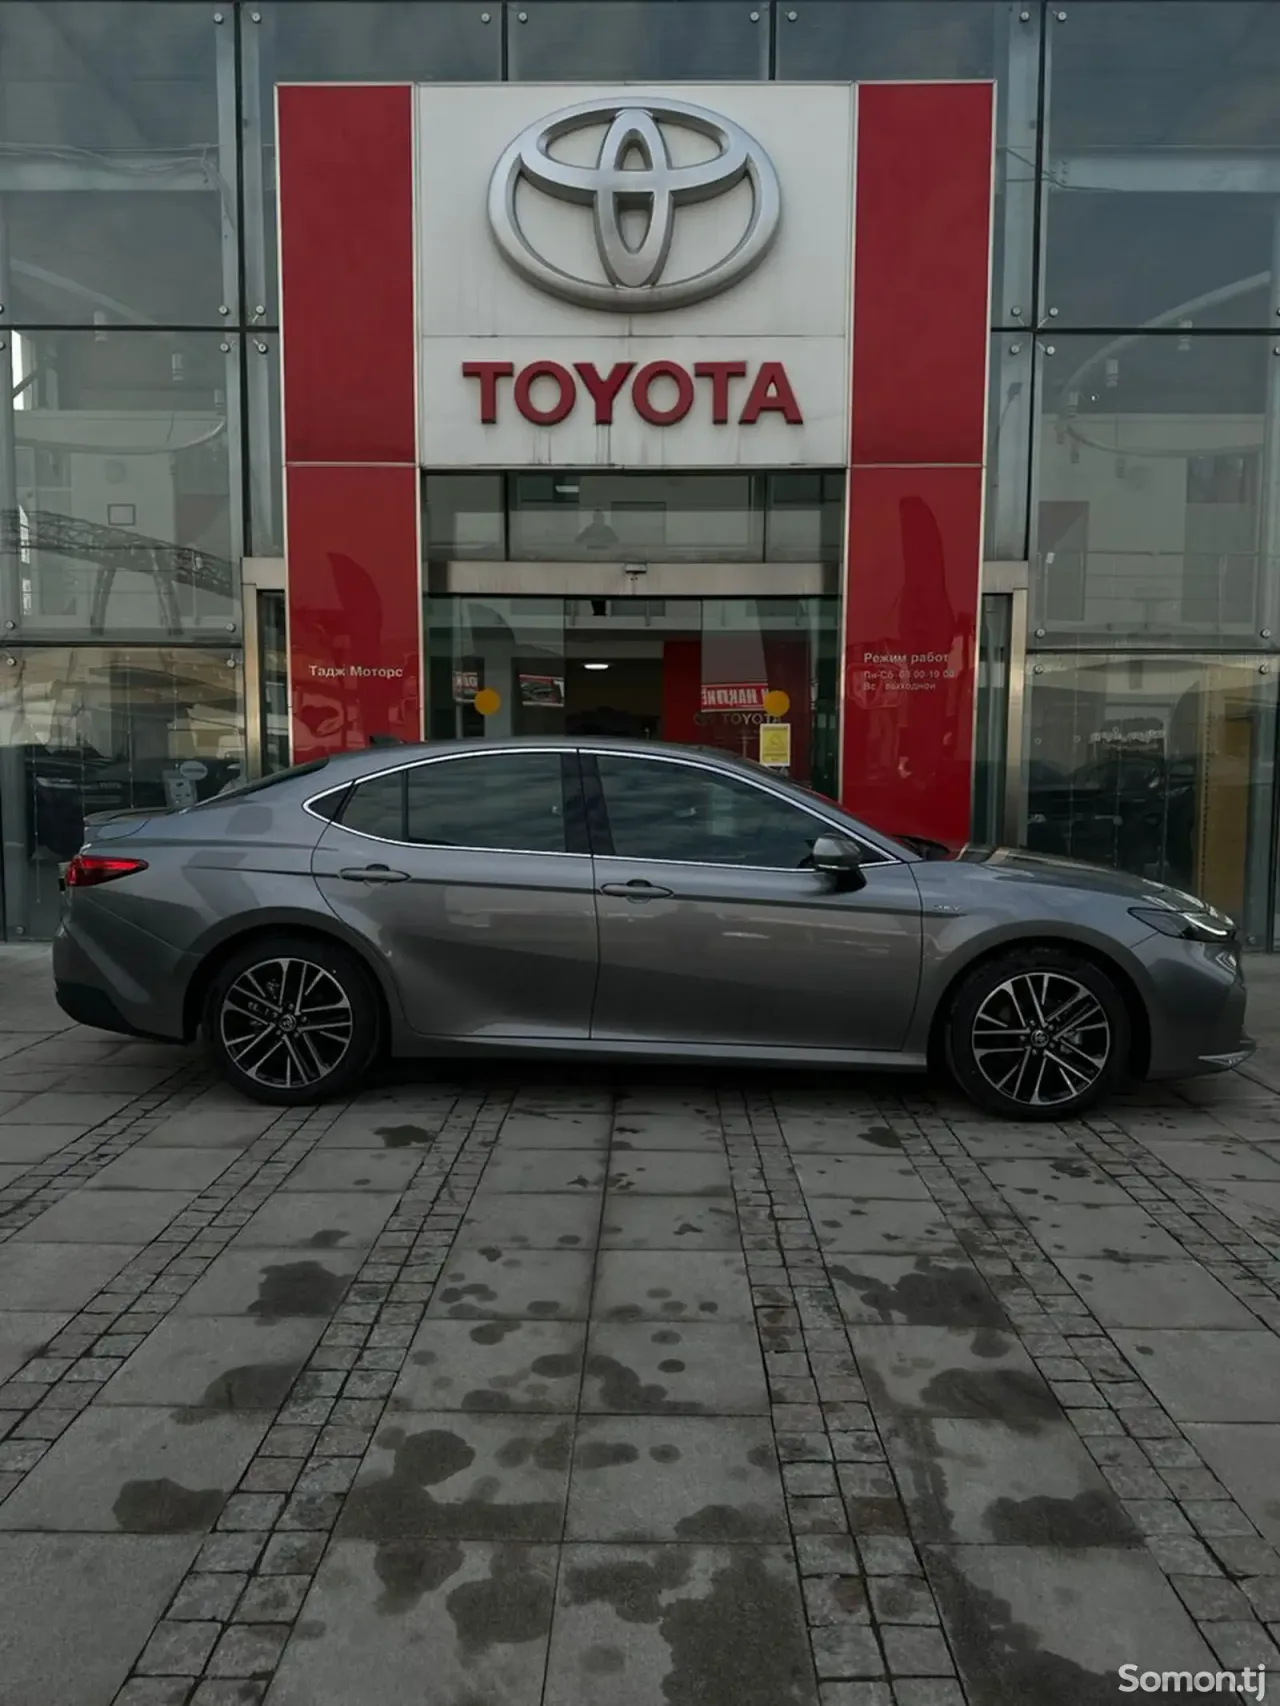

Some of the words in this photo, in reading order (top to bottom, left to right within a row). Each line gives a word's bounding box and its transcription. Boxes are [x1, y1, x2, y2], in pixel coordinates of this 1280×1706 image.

[462, 360, 804, 427] TOYOTA
[863, 652, 907, 663] Режим
[309, 664, 345, 678] Тадж
[350, 665, 404, 679] Моторс
